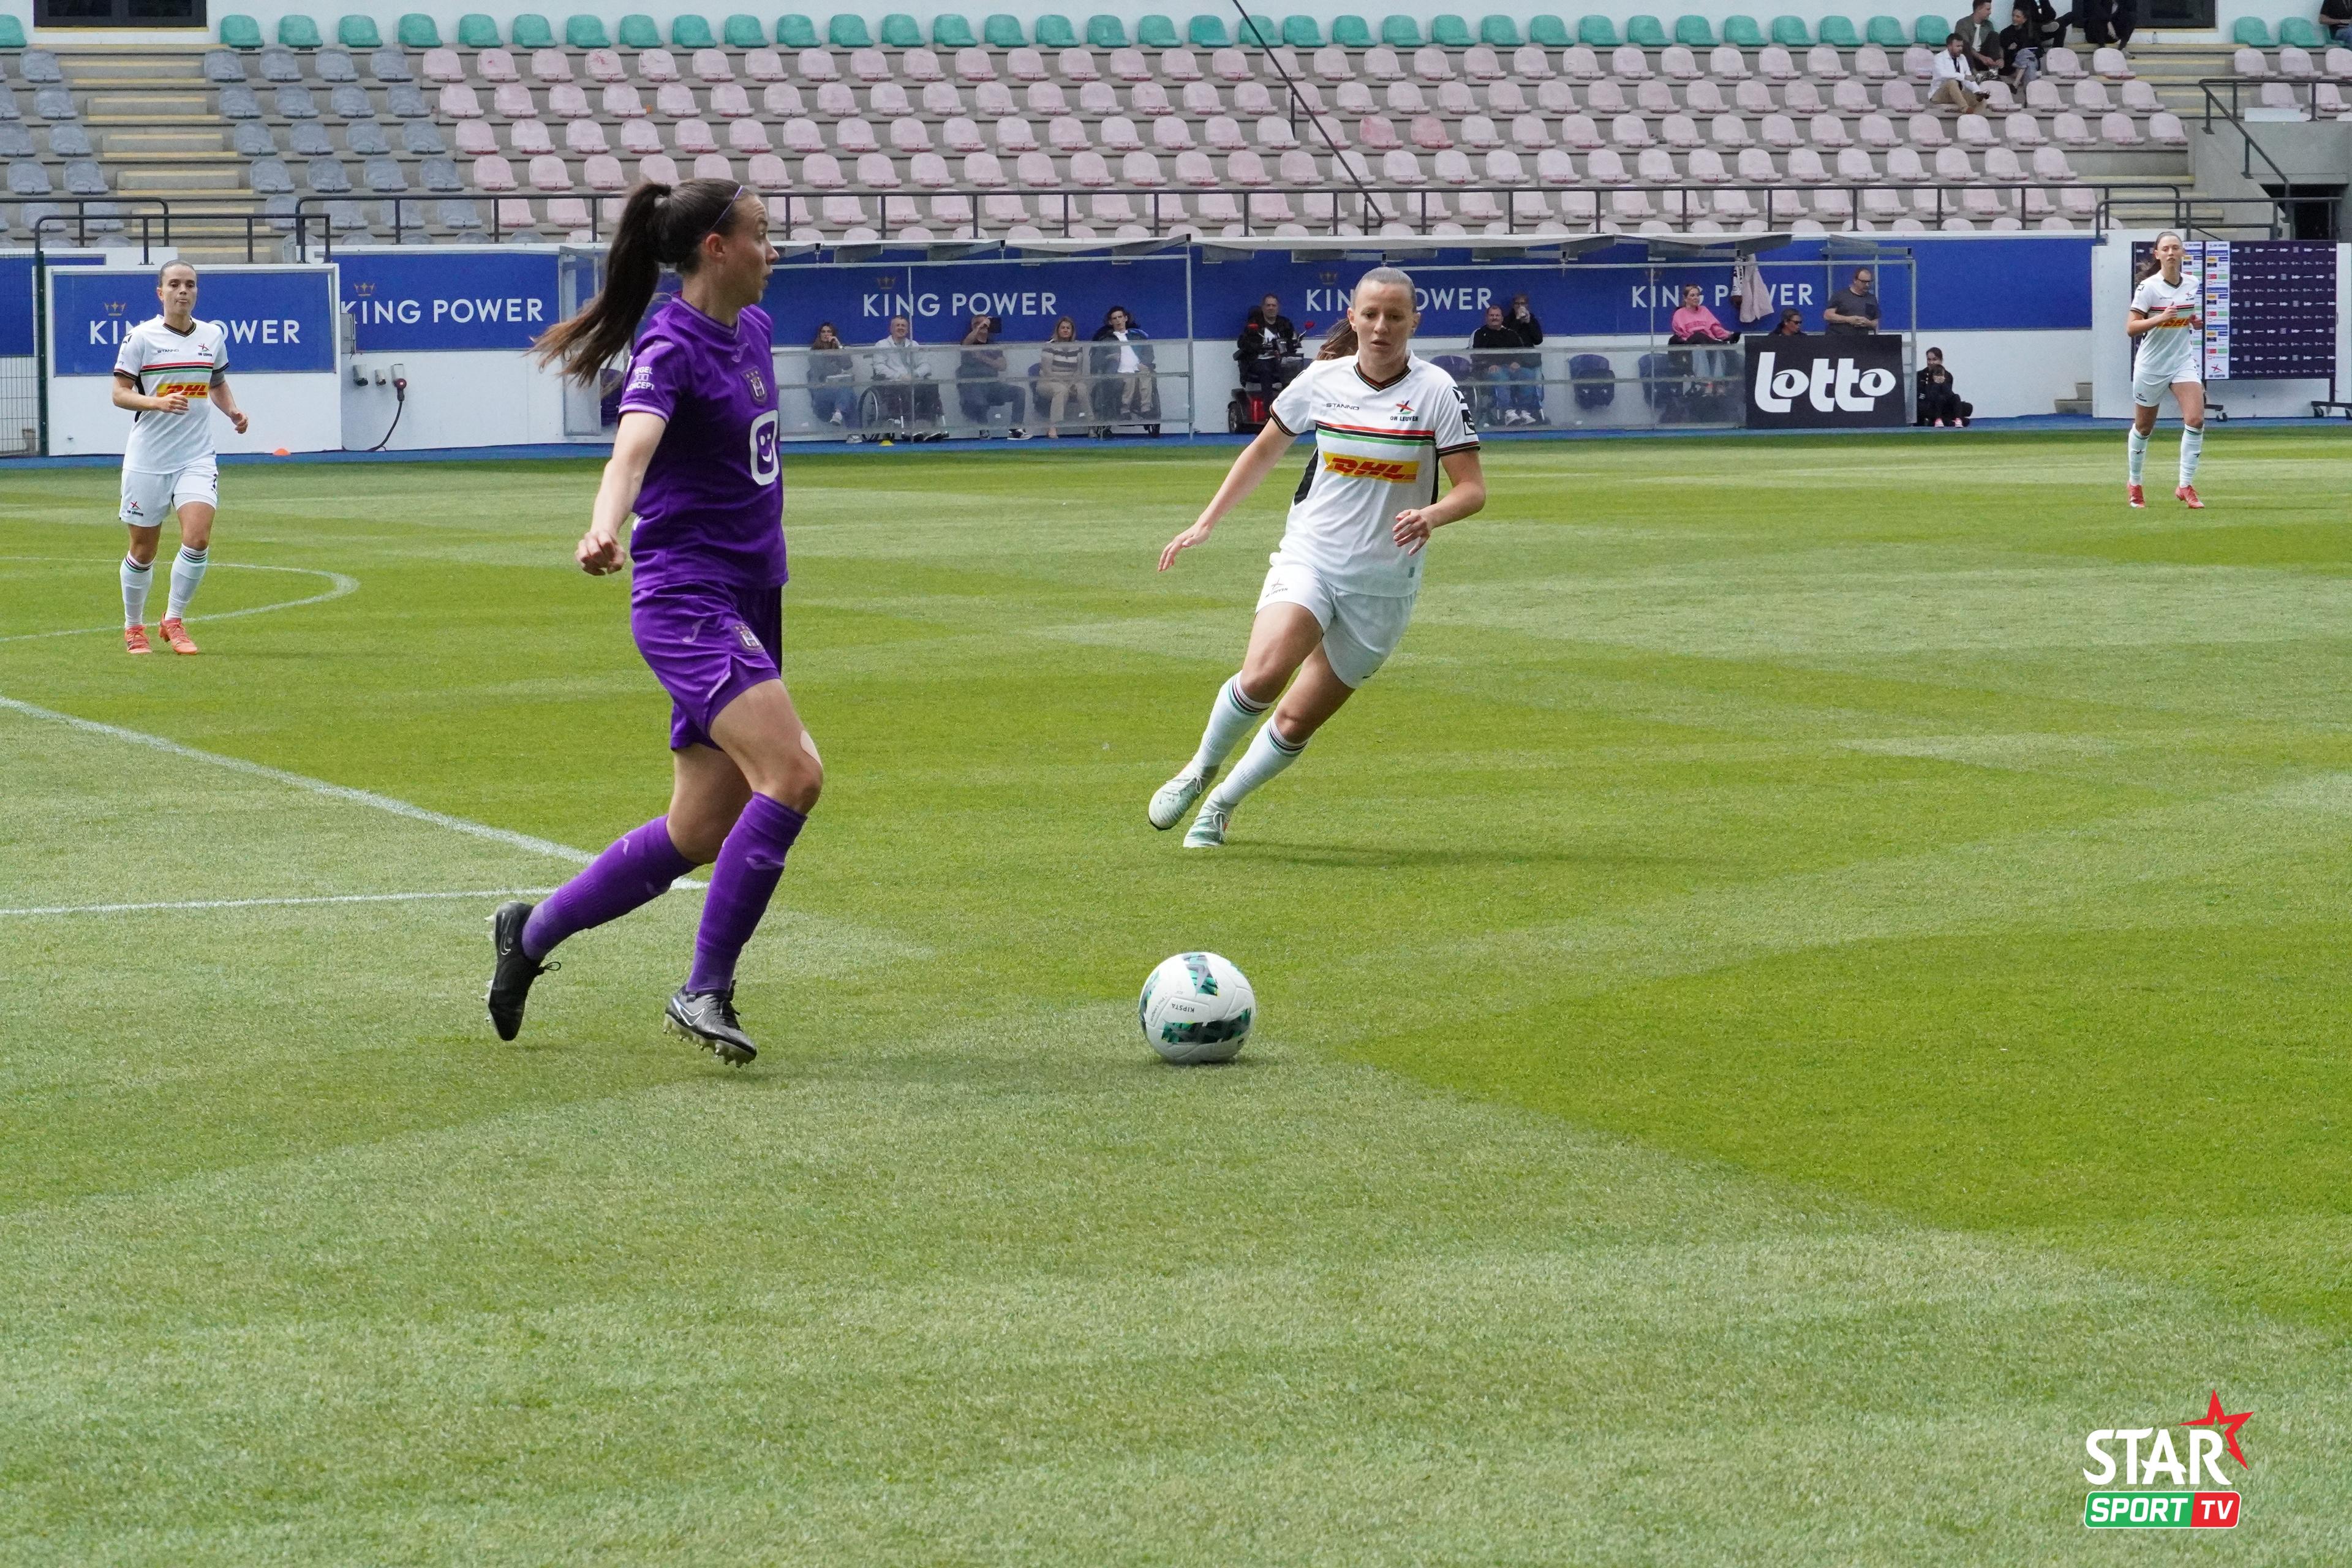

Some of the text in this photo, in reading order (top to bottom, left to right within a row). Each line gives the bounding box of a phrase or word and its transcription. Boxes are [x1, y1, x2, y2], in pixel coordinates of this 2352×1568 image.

[863, 292, 1057, 317] KING POWER
[1306, 288, 1492, 312] KIN OWER
[1715, 284, 1814, 306] PER
[434, 298, 543, 323] POWER
[90, 320, 144, 345] KI
[166, 385, 207, 396] DHL
[1332, 457, 1406, 480] DHL
[1171, 1003, 1195, 1012] KIPSTA
